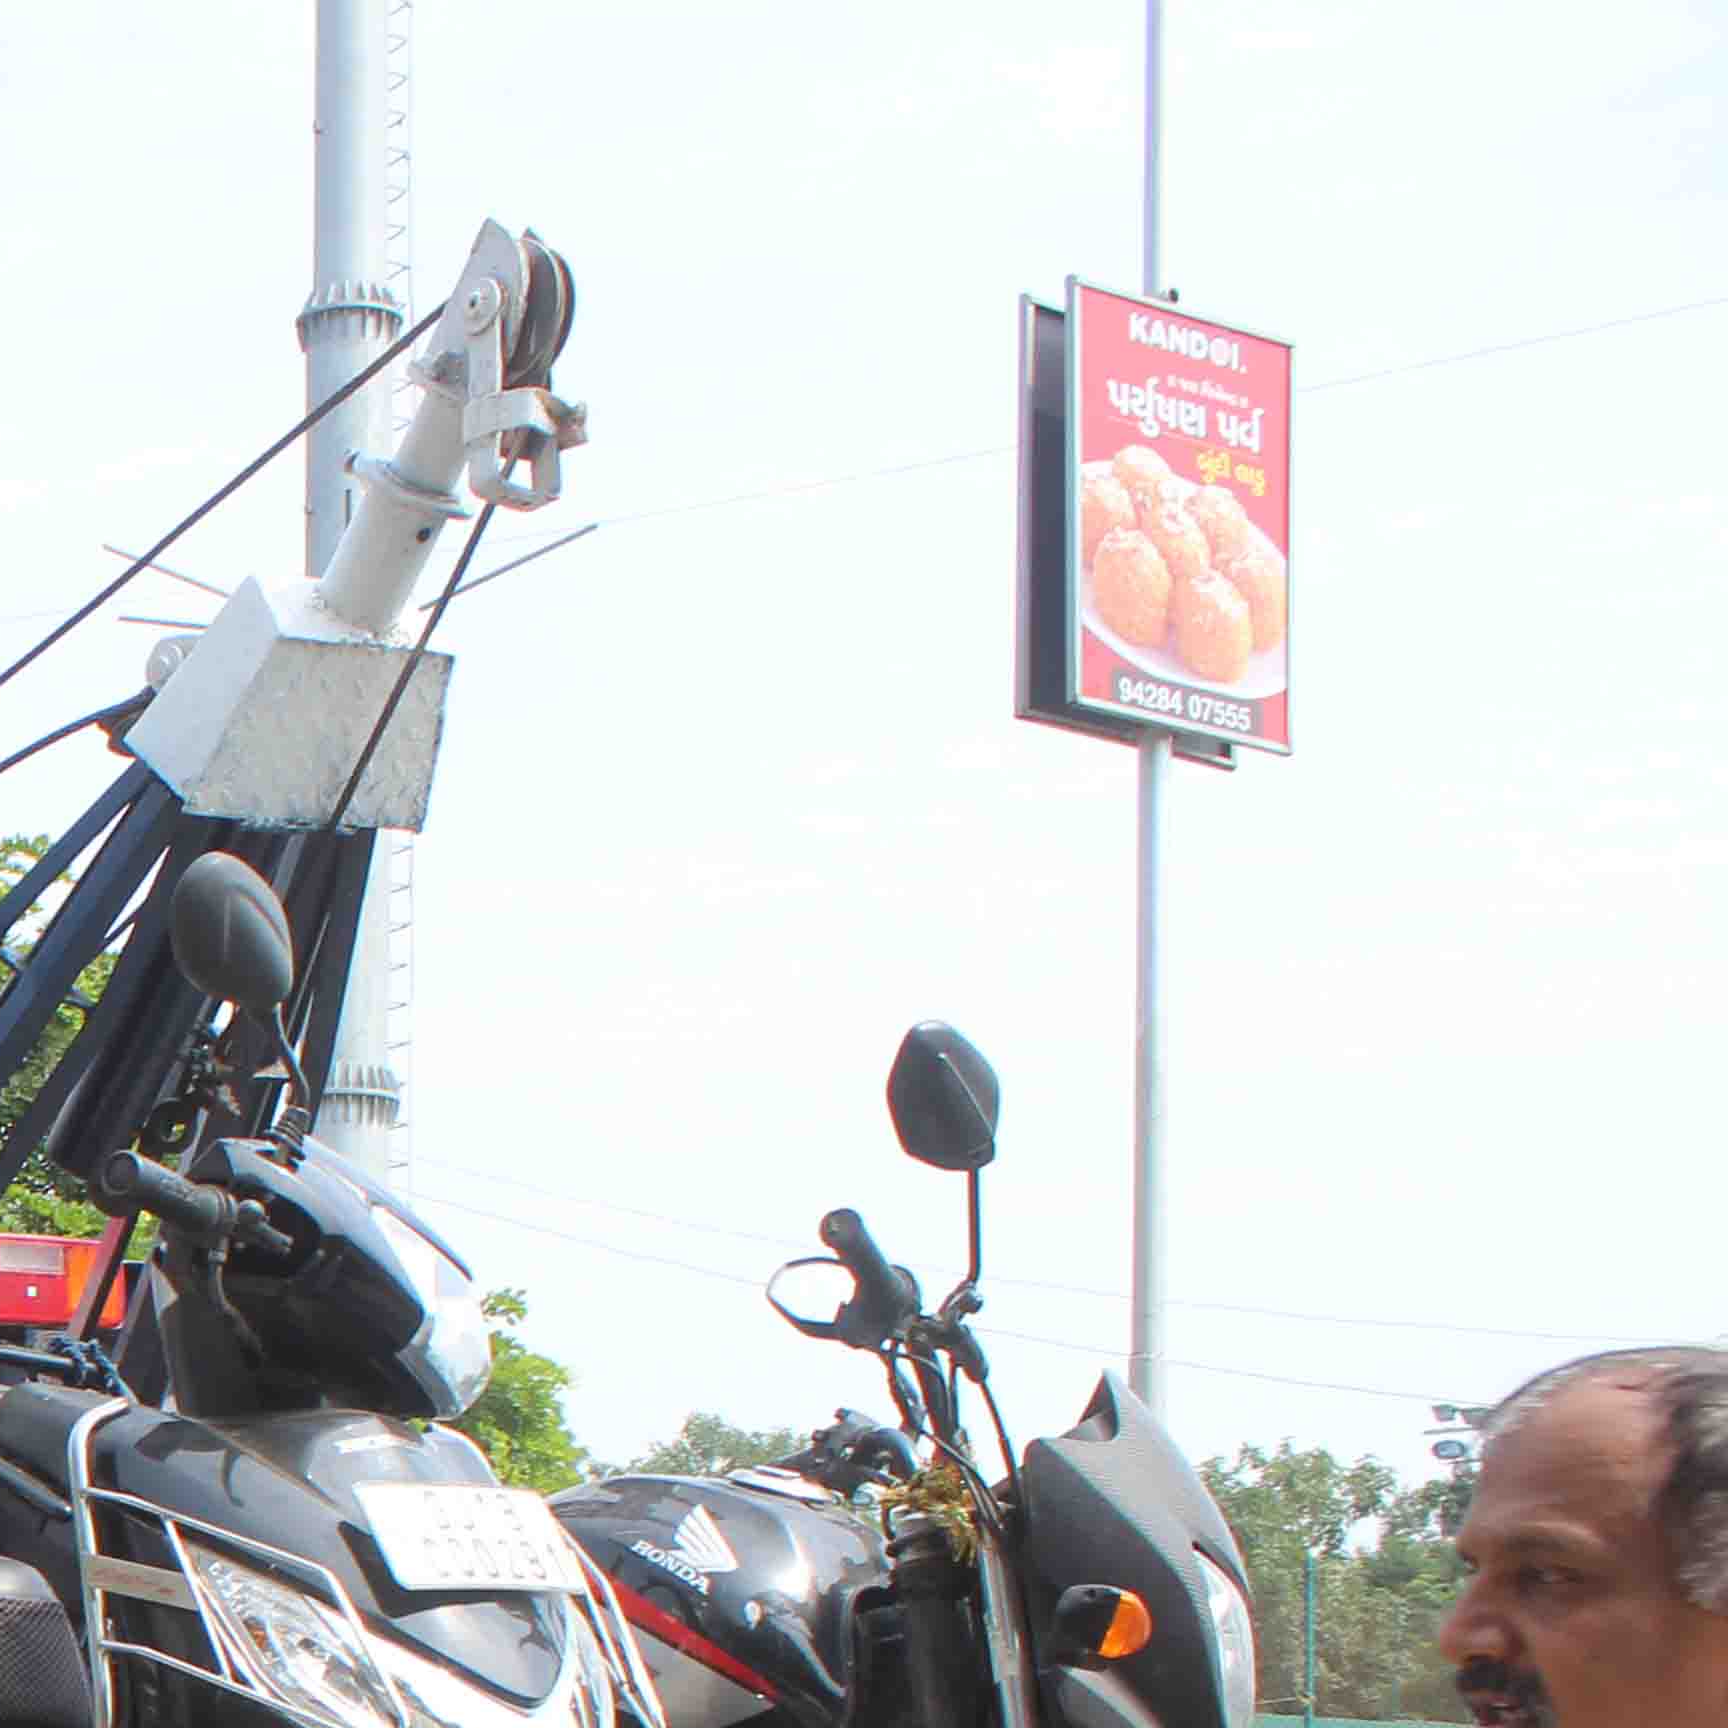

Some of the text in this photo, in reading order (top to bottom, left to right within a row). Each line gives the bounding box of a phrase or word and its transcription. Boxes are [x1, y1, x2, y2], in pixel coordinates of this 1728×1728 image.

[1118, 676, 1252, 732] 94284 07555
[630, 1538, 711, 1596] HONDA
